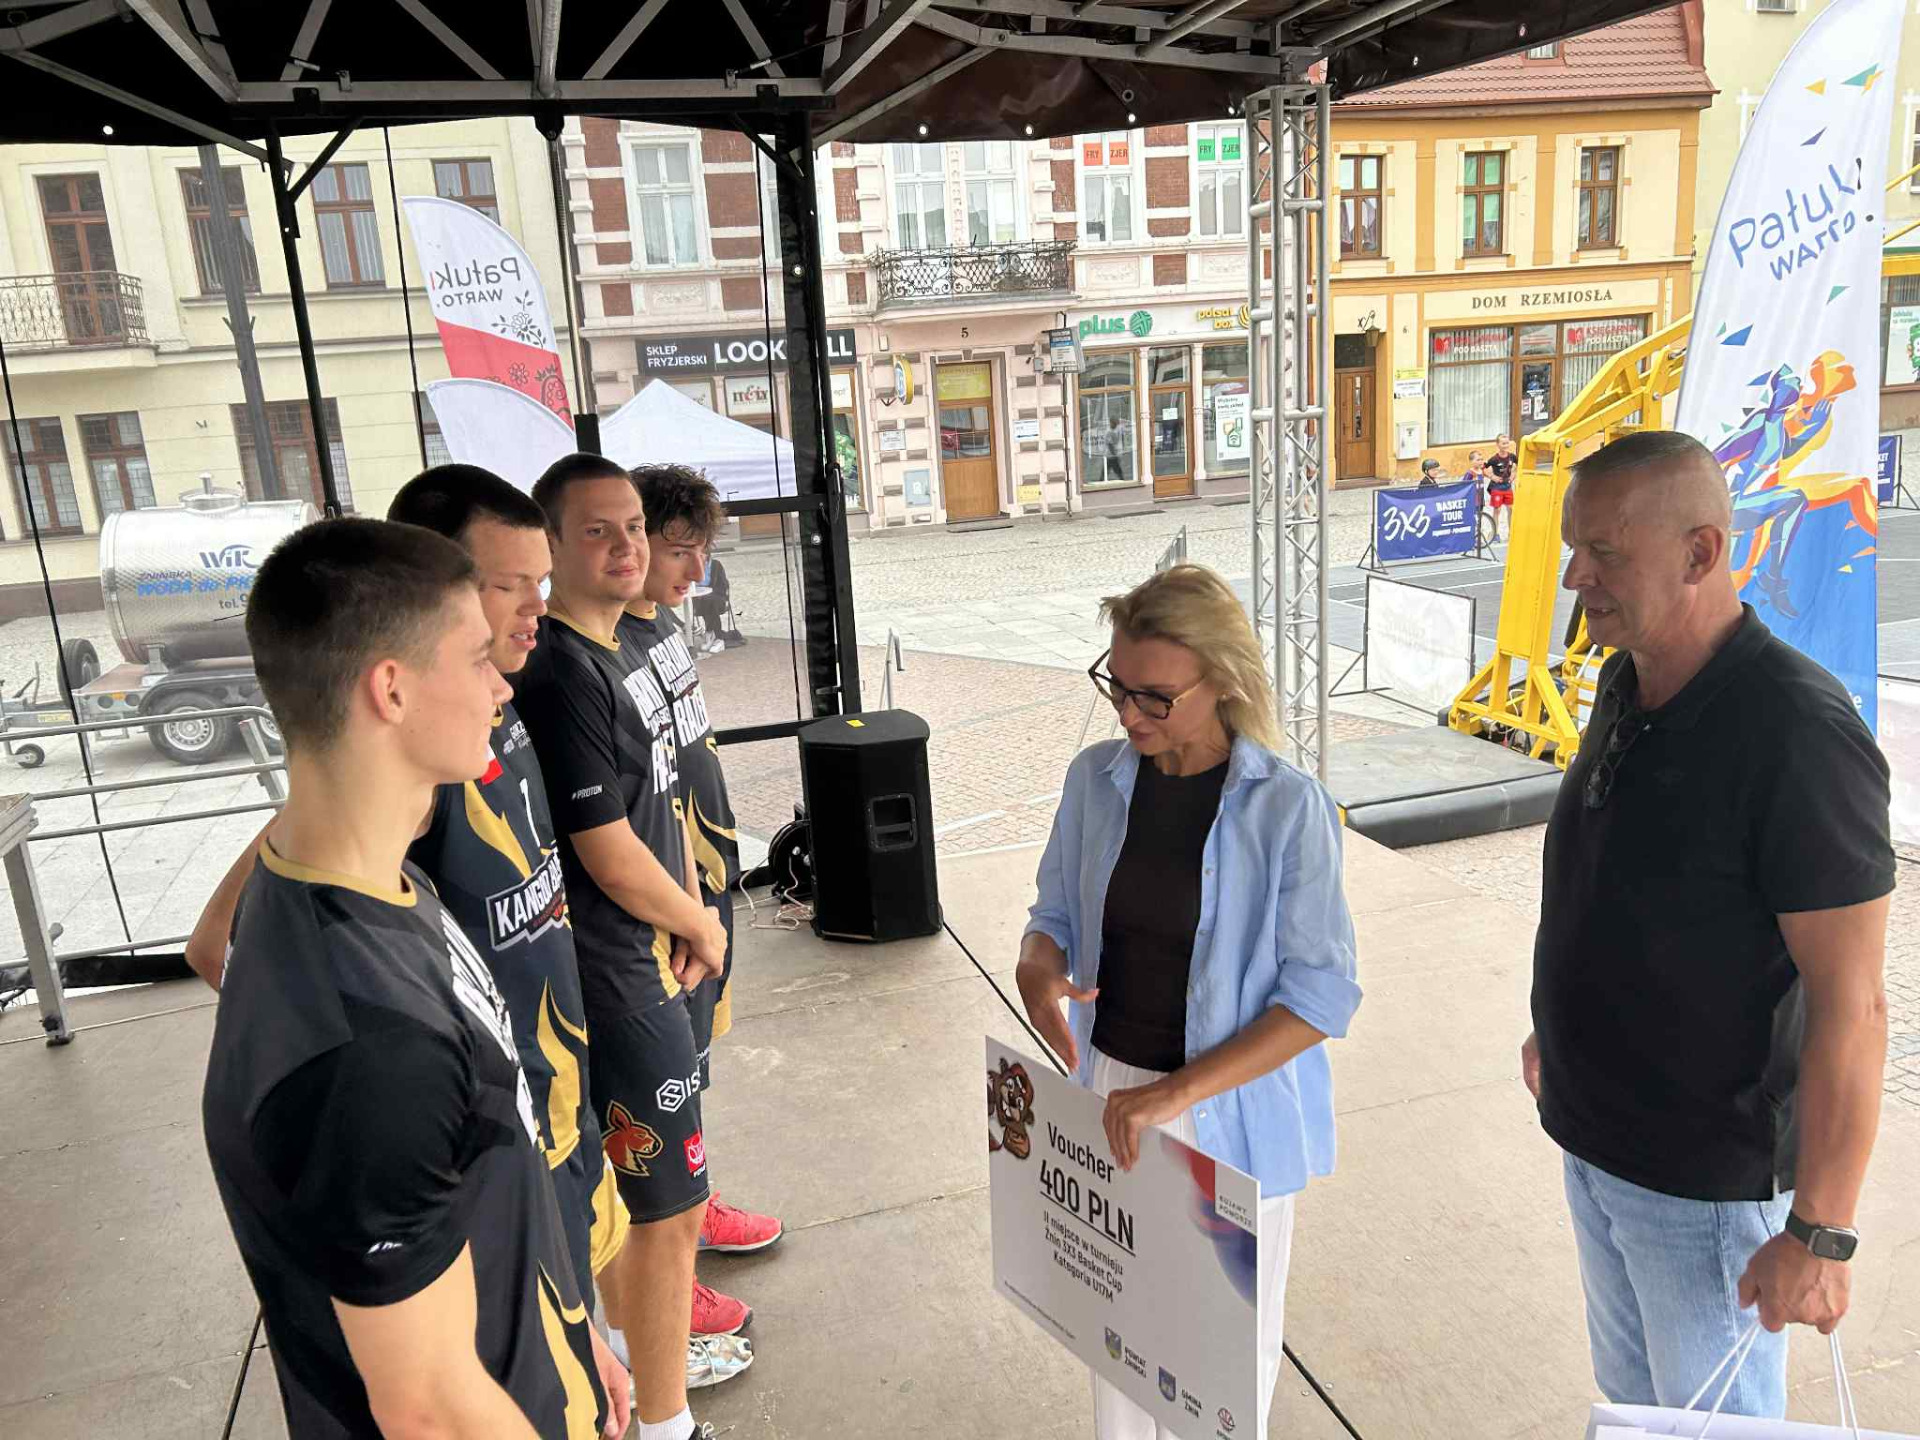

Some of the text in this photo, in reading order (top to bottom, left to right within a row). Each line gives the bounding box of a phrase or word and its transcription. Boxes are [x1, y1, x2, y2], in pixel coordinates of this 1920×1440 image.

[1086, 150, 1099, 159] FRY
[1200, 145, 1212, 153] FRY
[1472, 289, 1613, 310] DOM RZEMIOSŁA
[961, 327, 970, 339] 5
[1079, 315, 1125, 340] plus
[646, 345, 678, 356] SKLEP
[647, 355, 707, 367] FRYZJERSKI
[1435, 499, 1468, 512] BASKET
[1442, 510, 1463, 521] TOUR
[137, 580, 193, 597] WODA
[1047, 1122, 1114, 1184] Voucher
[1040, 1159, 1134, 1250] 400 PLN
[1051, 1217, 1080, 1246] miejsce
[1082, 1239, 1089, 1251] w
[1090, 1244, 1123, 1276] turnieju
[1054, 1250, 1091, 1287] Kategoria
[1078, 1251, 1105, 1280] Basket
[1106, 1271, 1123, 1293] Cup
